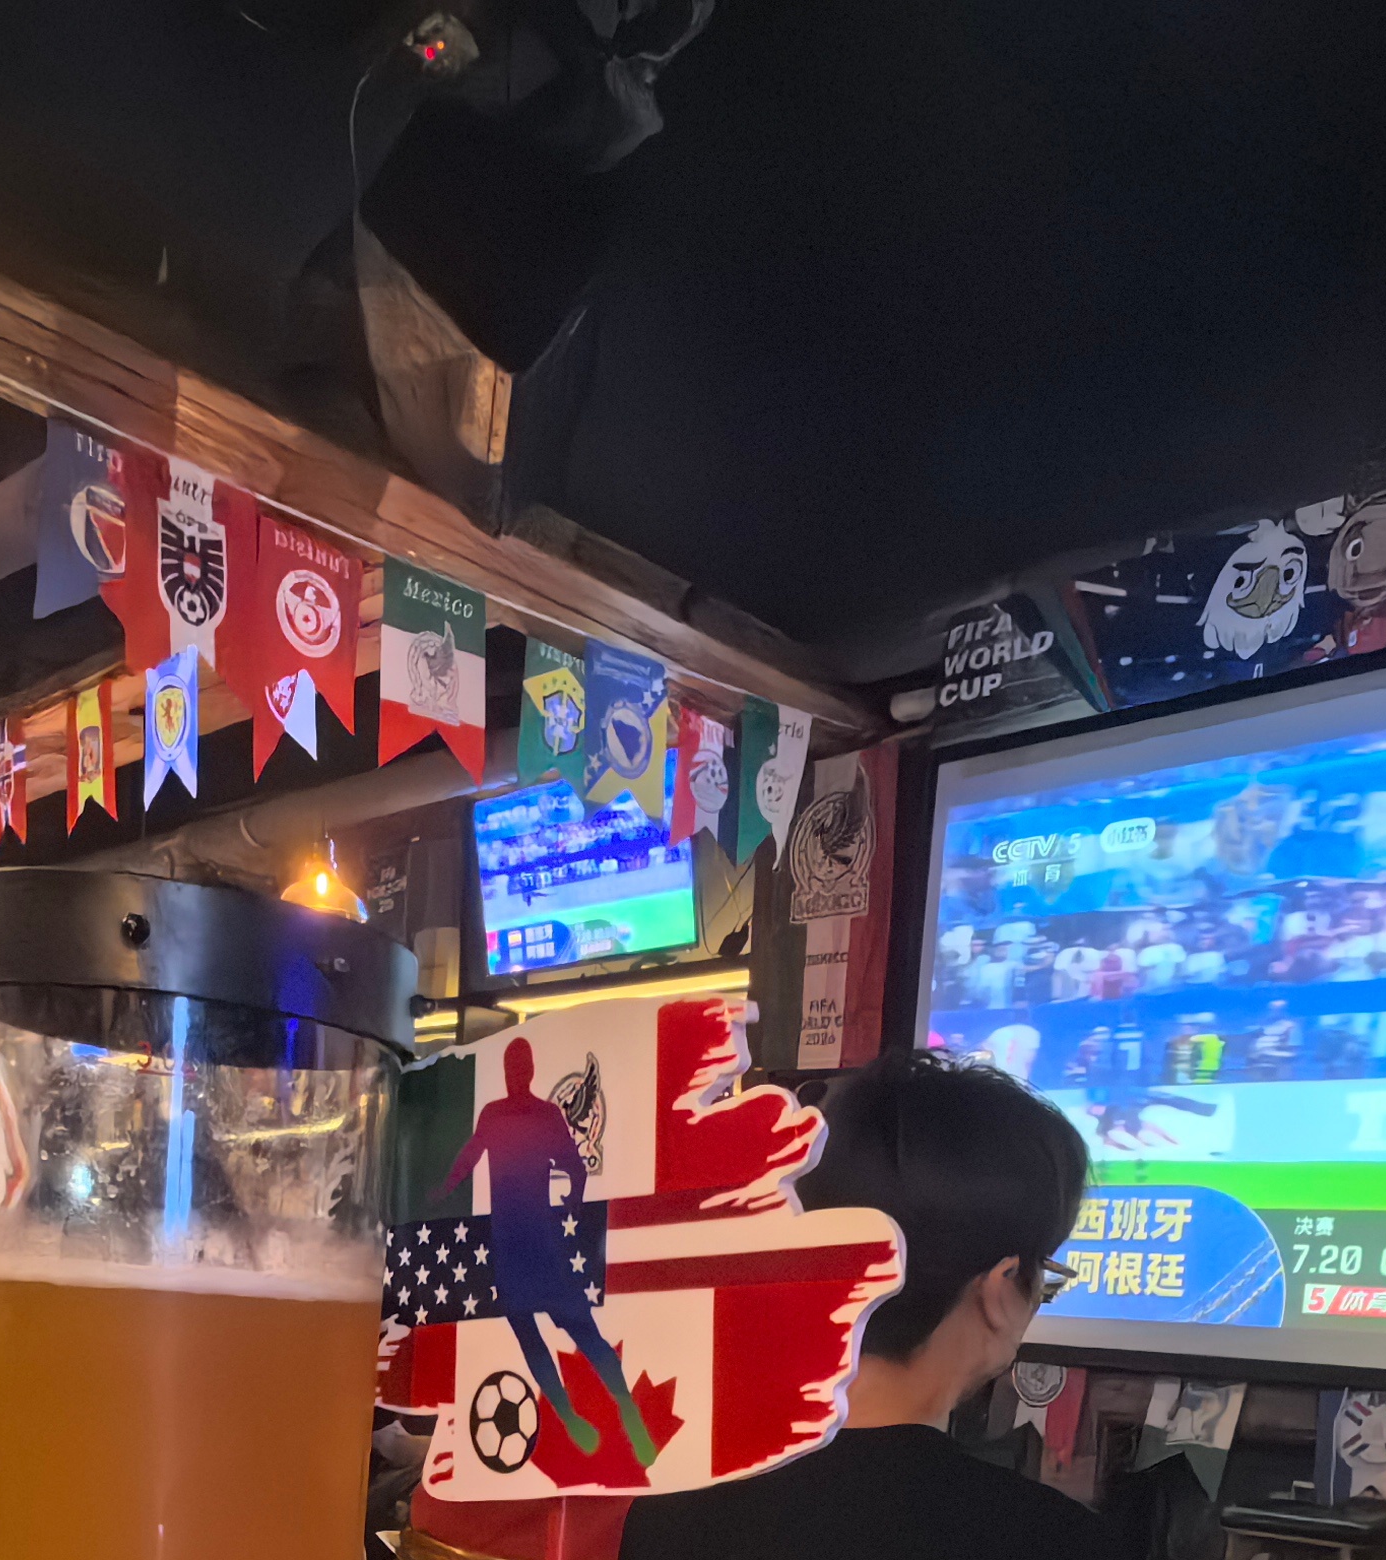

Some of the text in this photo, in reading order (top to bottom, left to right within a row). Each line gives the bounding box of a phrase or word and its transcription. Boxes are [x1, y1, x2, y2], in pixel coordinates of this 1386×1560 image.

[403, 576, 474, 620] Mexico
[947, 612, 1012, 650] FIFA
[944, 630, 1054, 678] WORLD
[939, 672, 1002, 708] CUP
[992, 833, 1082, 864] CCTV 5
[1070, 1198, 1193, 1243] 西班牙
[1294, 1216, 1335, 1237] 决赛
[1062, 1250, 1186, 1298] 阿根廷
[1292, 1244, 1363, 1276] 7.20
[1307, 1287, 1328, 1312] 5
